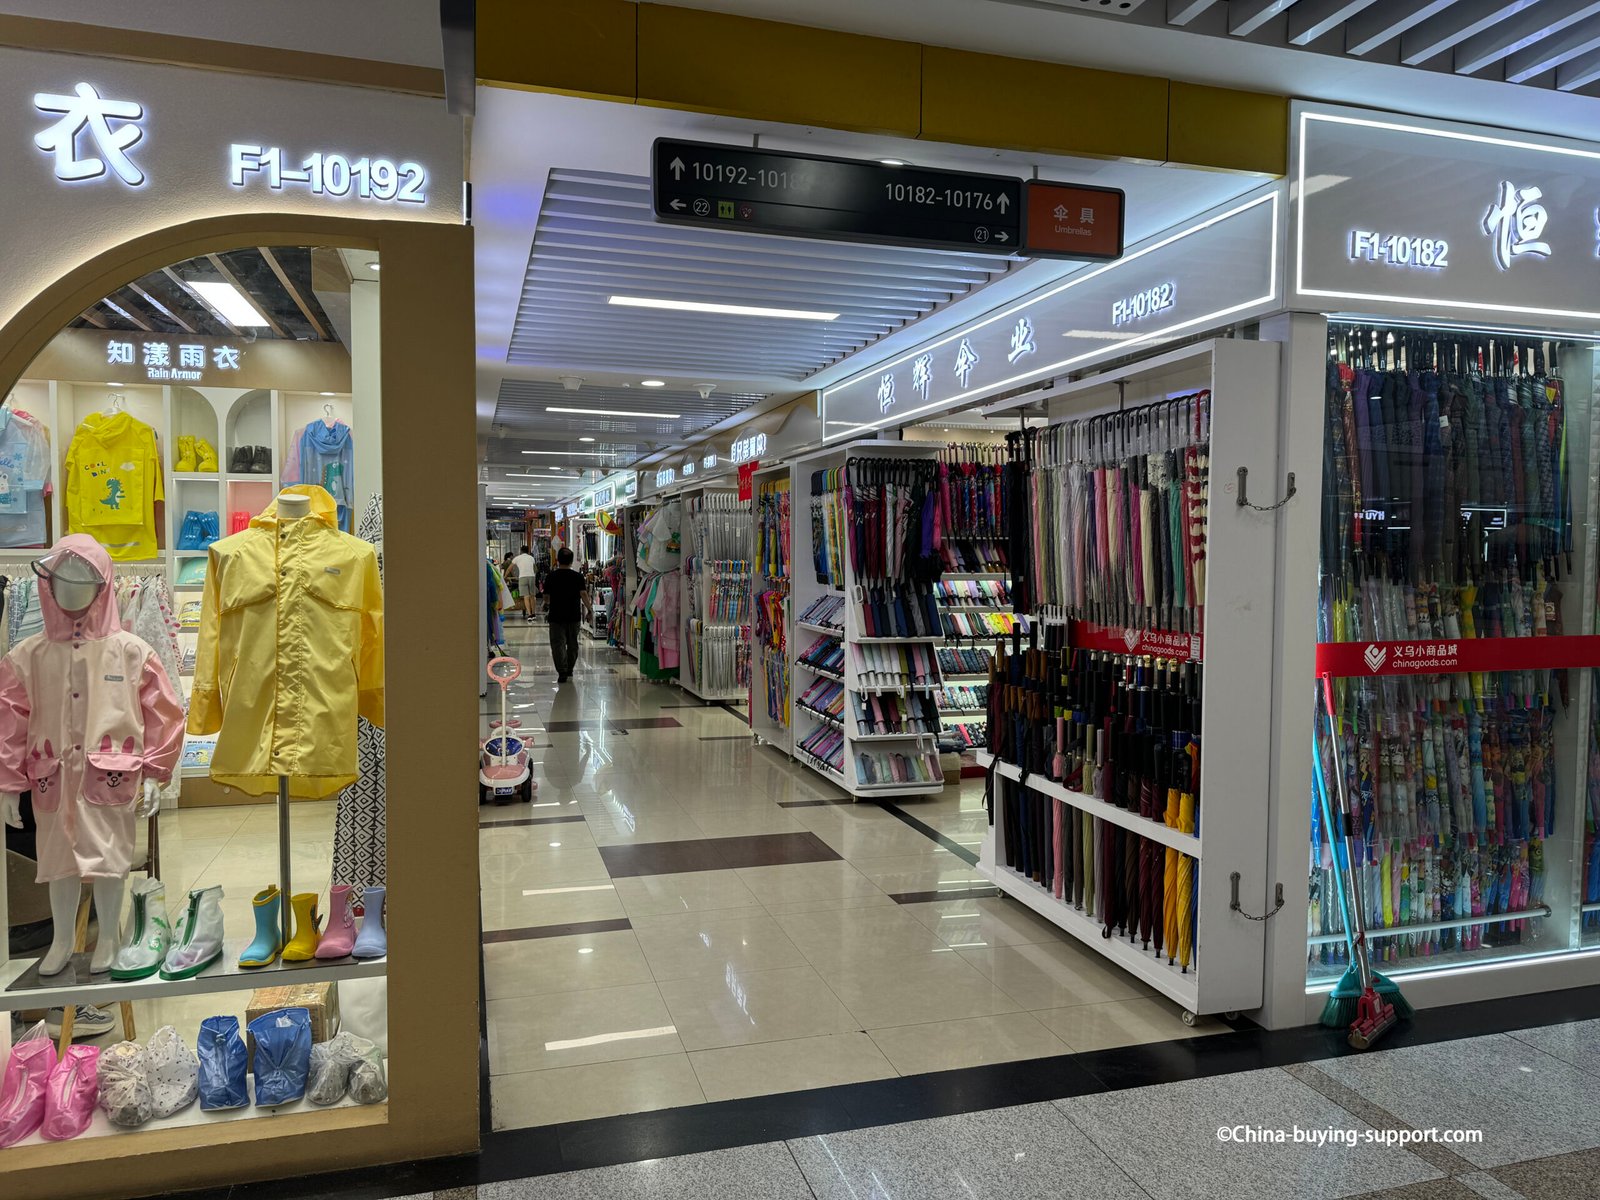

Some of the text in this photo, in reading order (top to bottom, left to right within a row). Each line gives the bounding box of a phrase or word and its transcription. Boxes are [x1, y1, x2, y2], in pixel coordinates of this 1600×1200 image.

[34, 82, 144, 186] 衣
[230, 143, 426, 203] F1-10192
[885, 183, 993, 211] 10182-10176
[695, 200, 708, 212] 22
[1053, 204, 1095, 224] 伞具
[976, 228, 989, 241] 21
[1054, 225, 1092, 236] Umbrellas
[1351, 230, 1449, 268] F1-10182
[1111, 284, 1174, 326] F1-10182
[107, 340, 240, 370] 知漾雨衣
[147, 367, 202, 380] Rain Armor
[1141, 644, 1188, 657] chinagoods.com
[1393, 644, 1458, 657] 义乌小商品城
[1392, 658, 1458, 670] chinagoods.com
